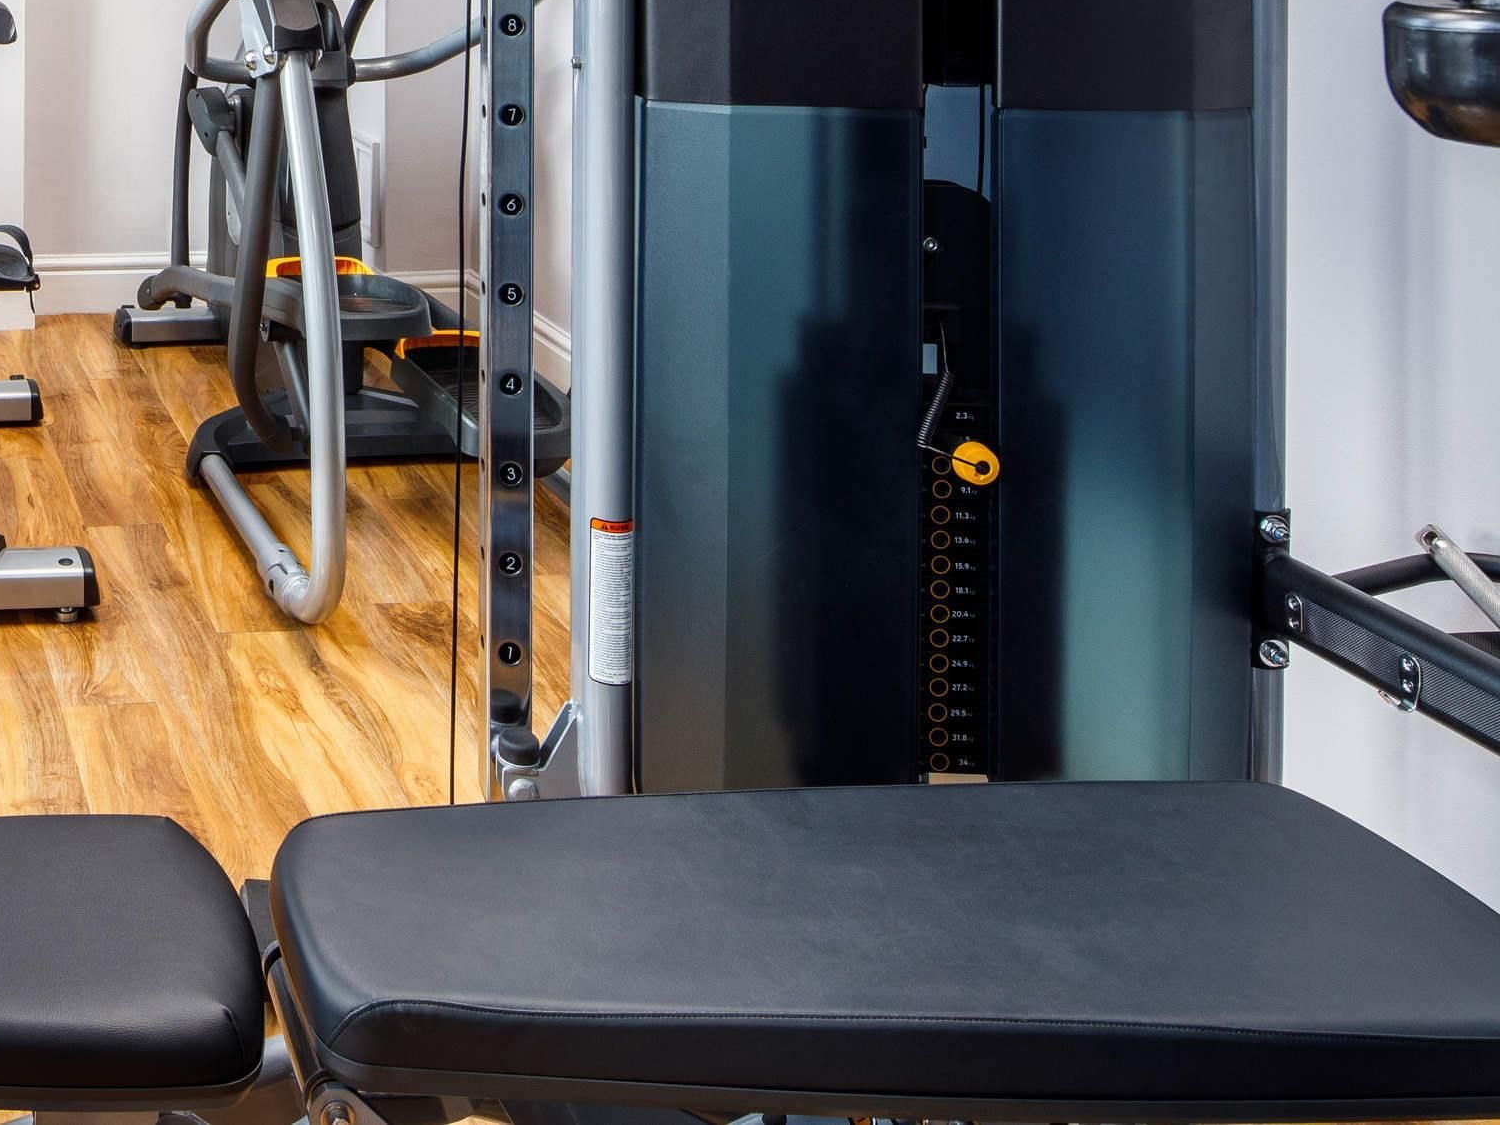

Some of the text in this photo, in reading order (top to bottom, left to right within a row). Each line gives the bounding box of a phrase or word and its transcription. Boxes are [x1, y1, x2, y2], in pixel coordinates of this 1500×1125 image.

[508, 18, 518, 33] 8
[508, 108, 517, 122] 7
[506, 198, 516, 212] 6
[507, 288, 517, 302] 5
[506, 378, 515, 391] 4
[507, 467, 516, 481] 3
[506, 557, 516, 571] 2
